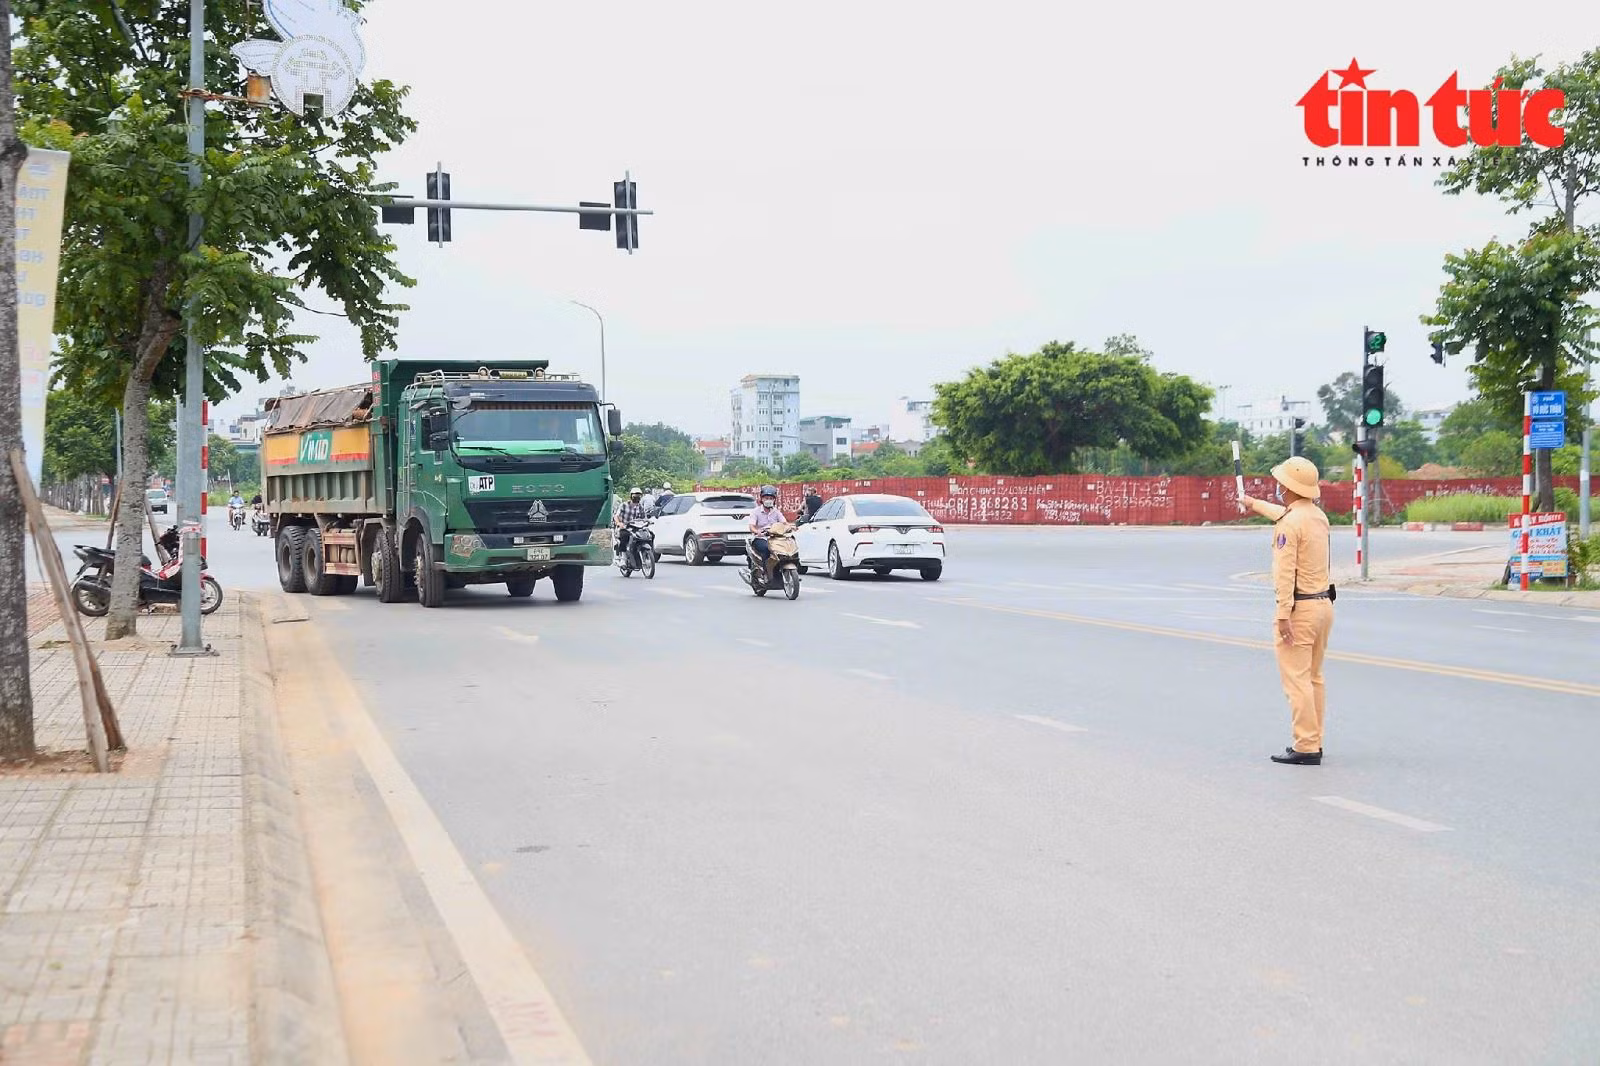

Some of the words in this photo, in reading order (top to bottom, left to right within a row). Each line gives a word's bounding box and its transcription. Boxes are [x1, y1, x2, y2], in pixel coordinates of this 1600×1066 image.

[479, 476, 494, 490] ATP
[1512, 528, 1533, 538] GII
[1536, 525, 1561, 536] KHÁT
